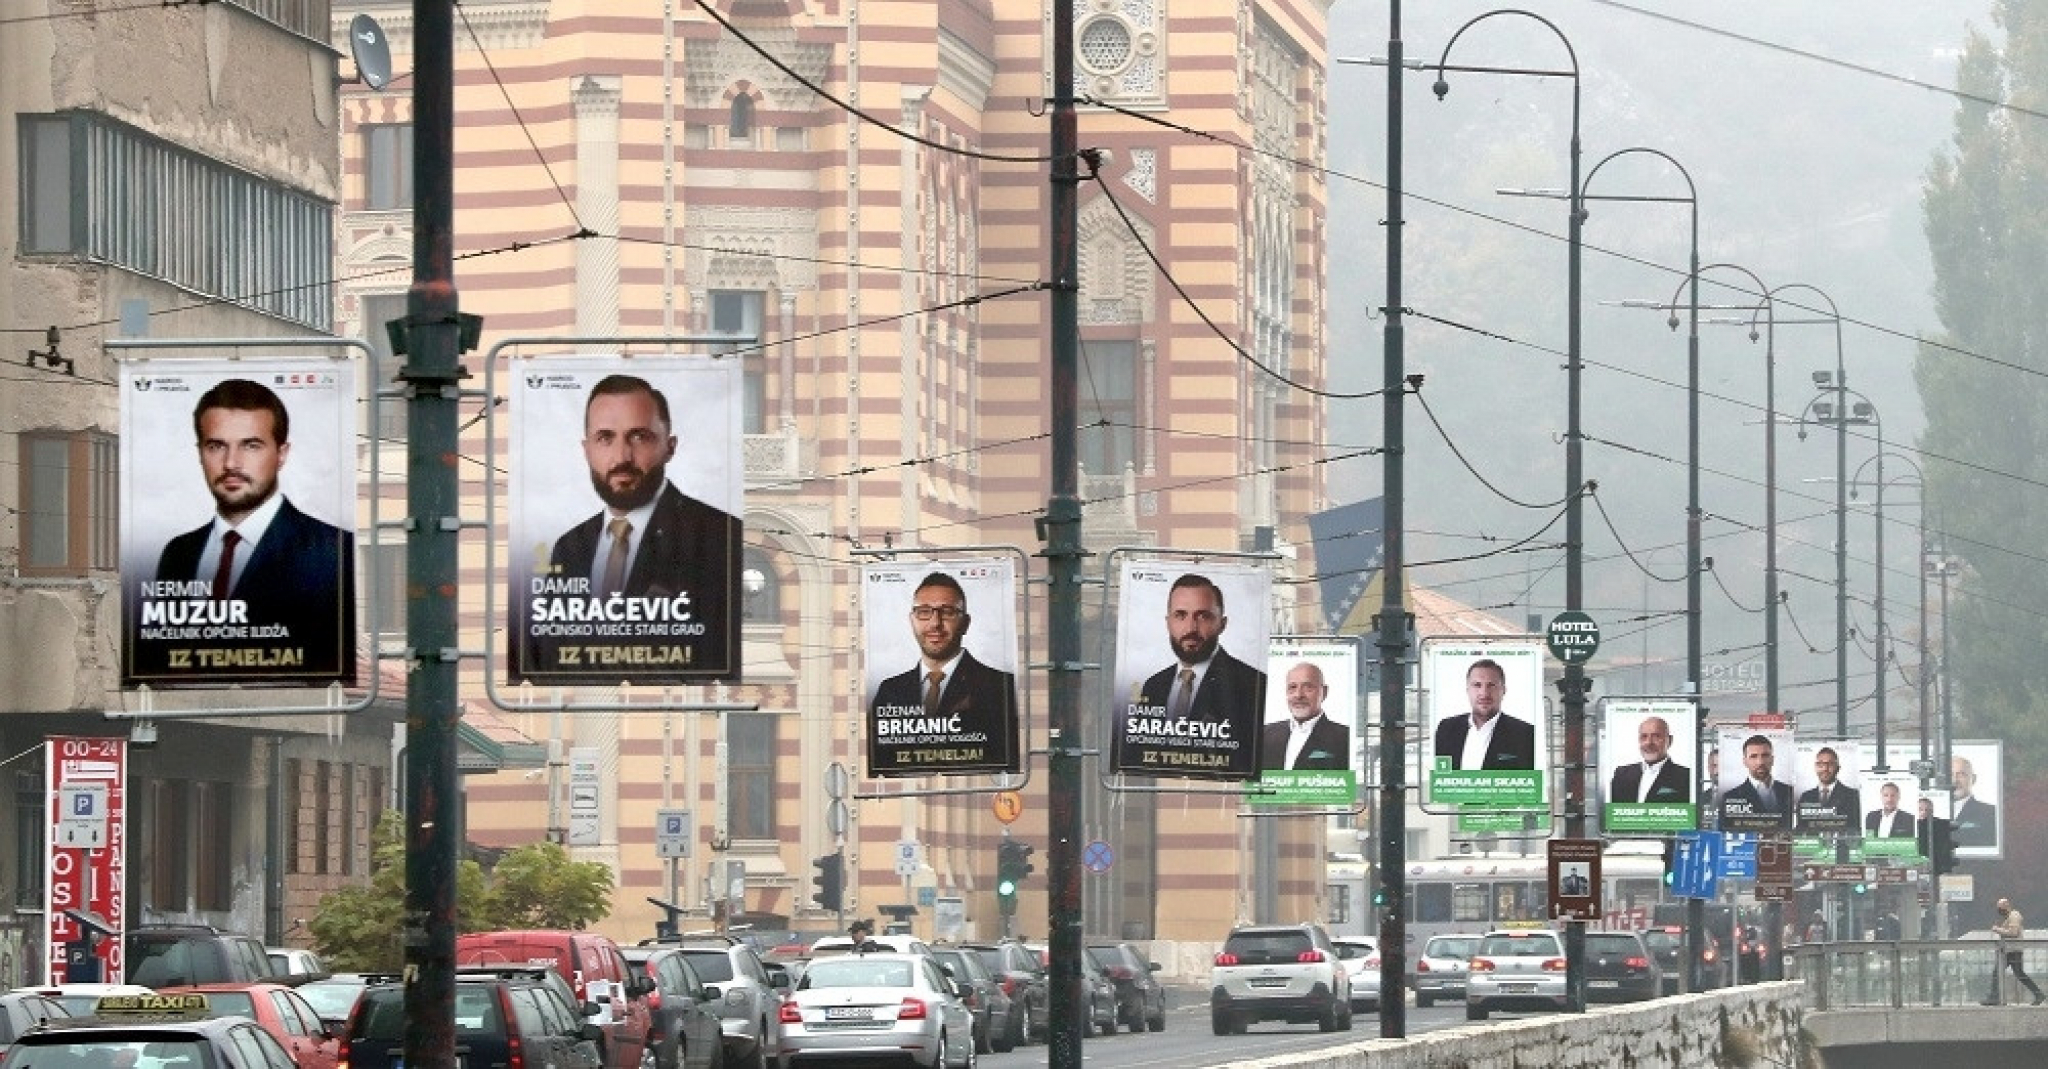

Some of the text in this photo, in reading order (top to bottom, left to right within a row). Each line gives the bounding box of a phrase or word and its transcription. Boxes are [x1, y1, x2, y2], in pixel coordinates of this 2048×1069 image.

[140, 581, 213, 597] NERMIN
[531, 577, 591, 594] DAMIR
[141, 601, 249, 625] MUZUR
[531, 592, 691, 621] SARAČEVIĆ
[635, 623, 668, 635] STARI
[671, 624, 705, 635] GRAD
[1552, 622, 1598, 631] HOTEL
[1552, 634, 1596, 645] LULA
[169, 647, 304, 667] IZ TEMELJA!
[558, 646, 691, 664] IZ TEMELJA!
[876, 703, 926, 717] DŽENAN
[1128, 704, 1166, 717] DAMIR
[878, 712, 962, 734] BRKANIĆ
[1126, 716, 1232, 738] SARAČEVIĆ
[1440, 761, 1447, 769] 1
[1433, 777, 1492, 787] ABDULAH
[140, 996, 183, 1008] TAXI
